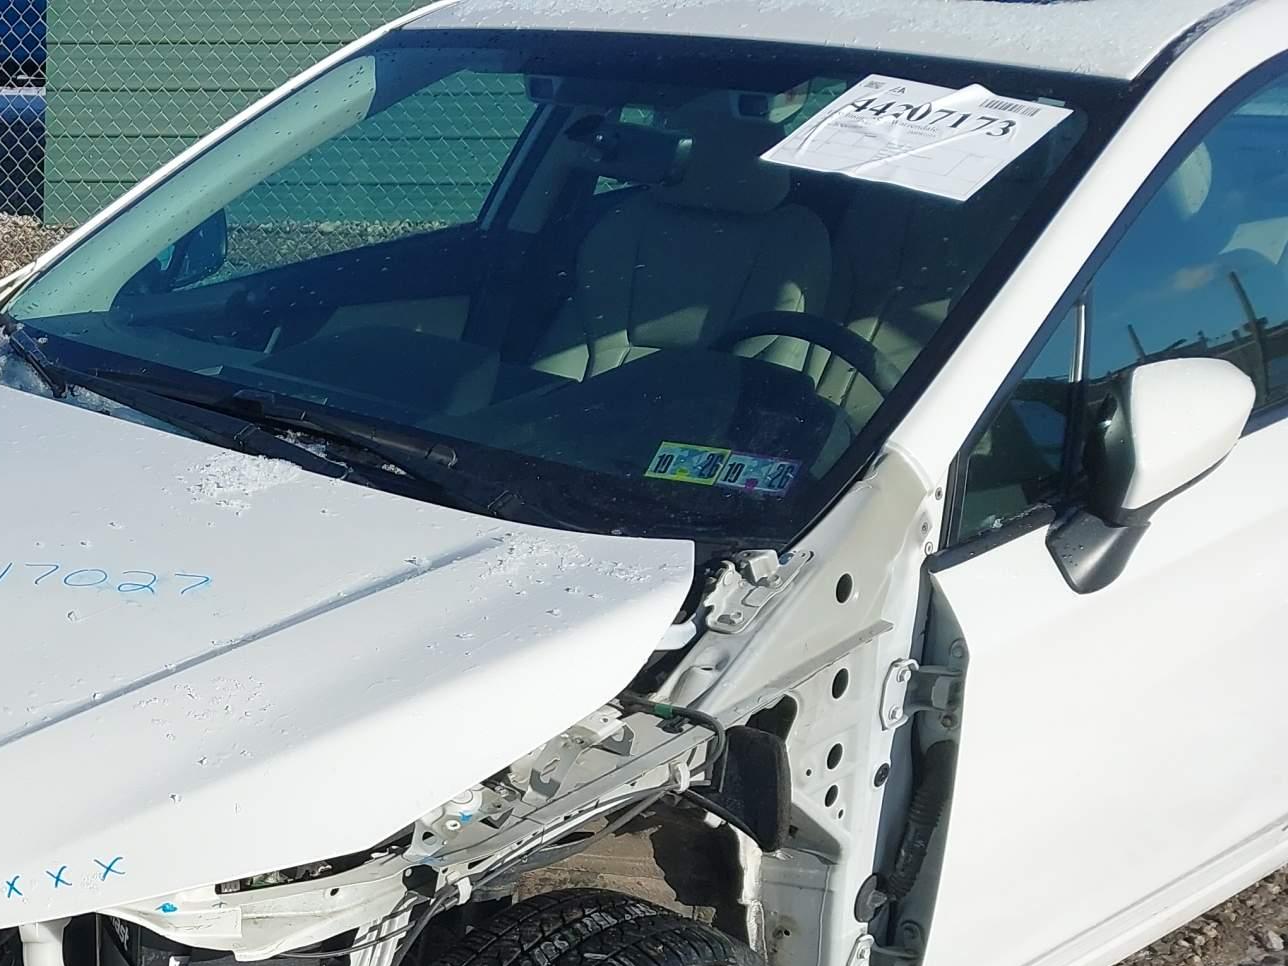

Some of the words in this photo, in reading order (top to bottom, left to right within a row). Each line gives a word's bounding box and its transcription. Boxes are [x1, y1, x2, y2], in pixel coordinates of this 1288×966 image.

[851, 97, 1016, 137] 44207173
[654, 454, 674, 474] 10
[700, 453, 723, 479] 26
[723, 463, 745, 483] 10
[767, 464, 794, 489] 26
